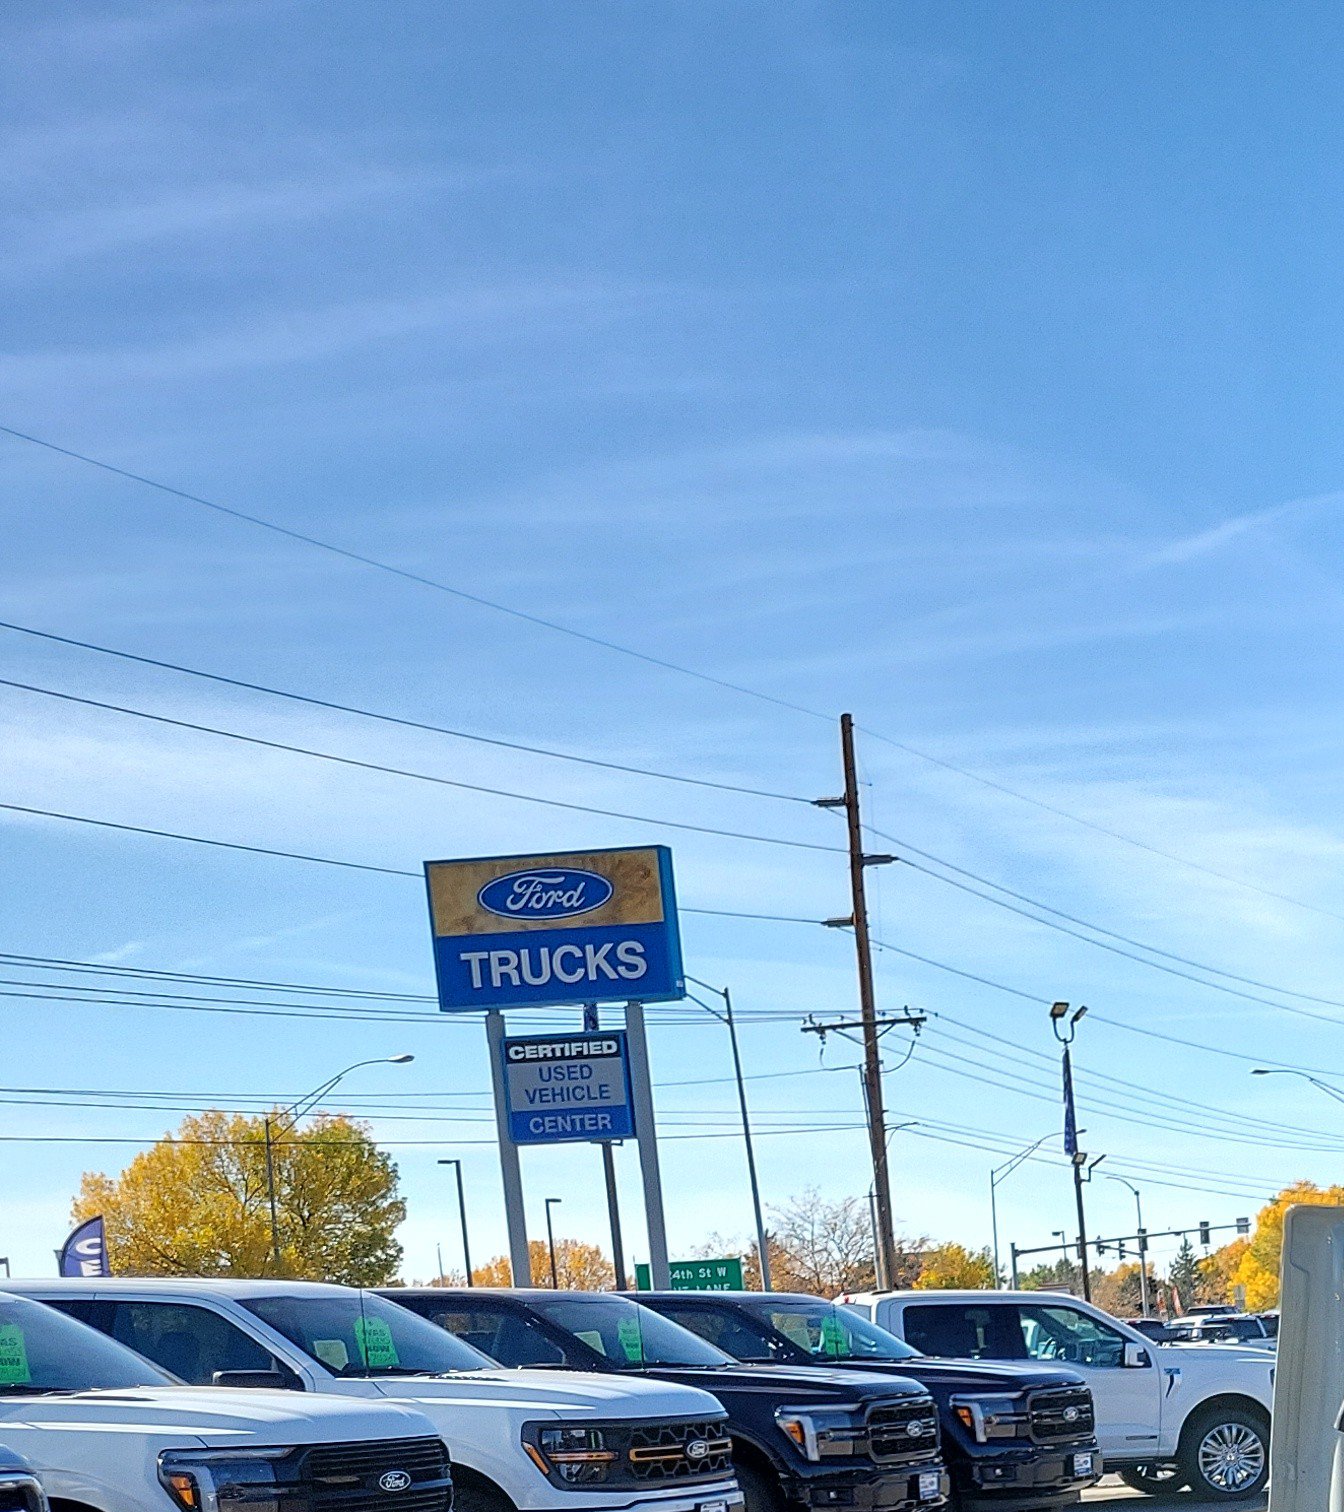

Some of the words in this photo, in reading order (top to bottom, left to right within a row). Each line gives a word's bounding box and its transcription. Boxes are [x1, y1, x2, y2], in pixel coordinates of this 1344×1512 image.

[505, 876, 586, 911] Ford
[459, 940, 648, 990] TRUCKS
[508, 1040, 618, 1061] CERTIFIED
[538, 1063, 593, 1083] USED
[524, 1083, 611, 1105] VEHICLE
[529, 1113, 612, 1135] CENTER
[669, 1269, 693, 1280] 4th
[699, 1267, 711, 1278] St
[717, 1266, 726, 1277] W
[383, 1473, 405, 1488] Ford
